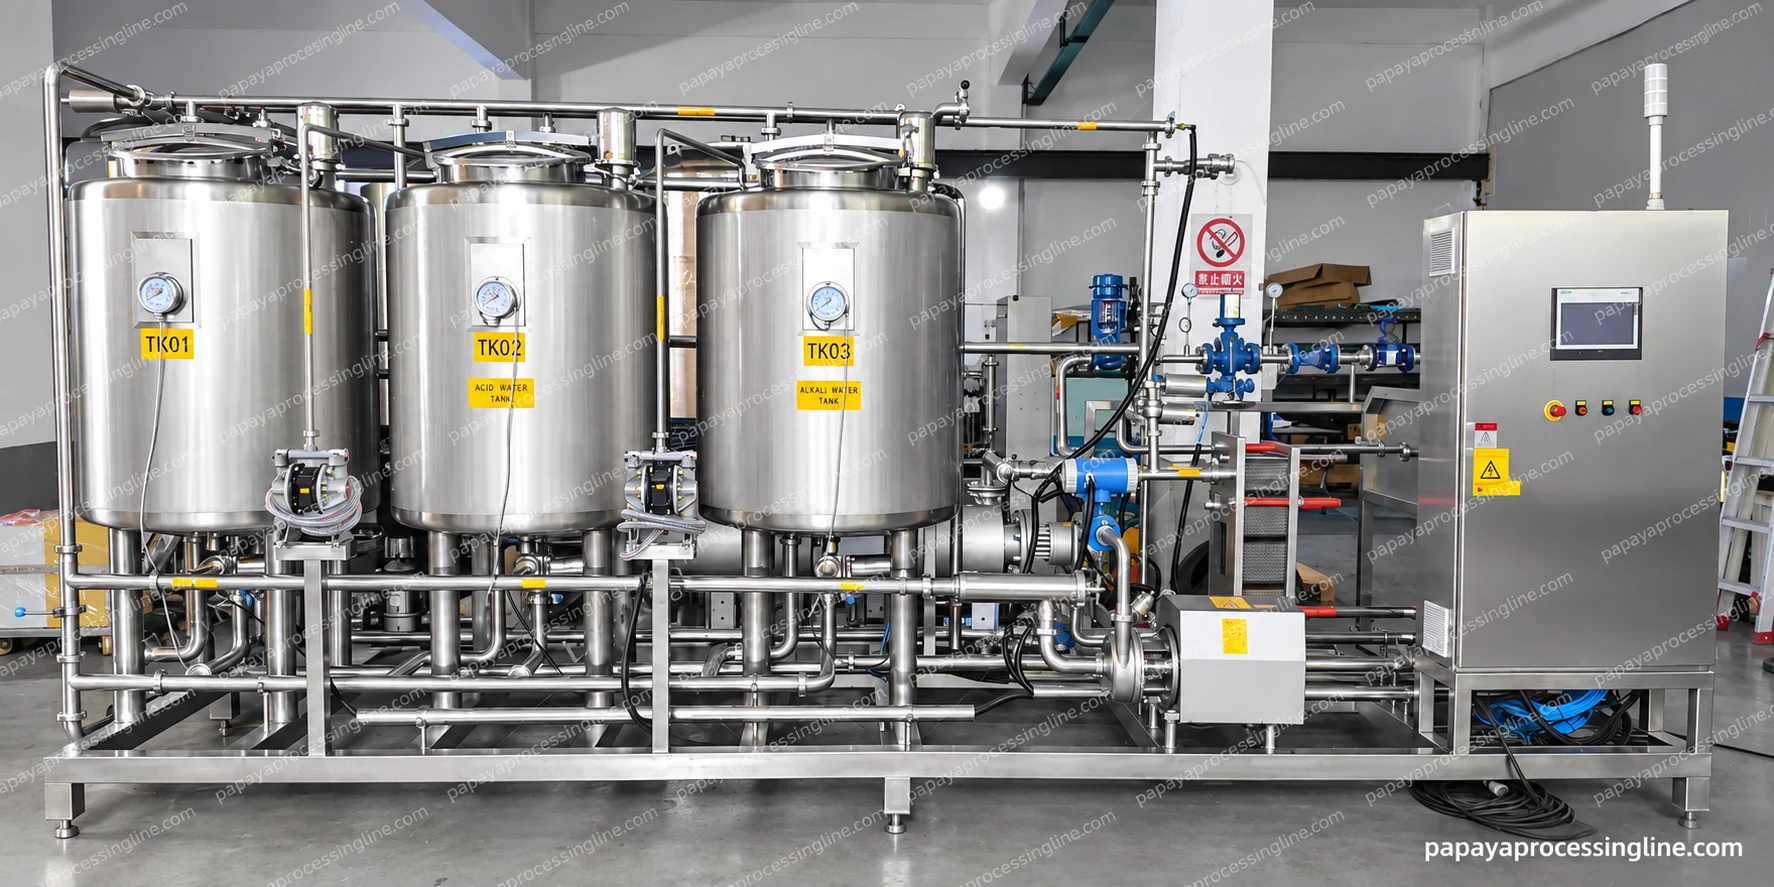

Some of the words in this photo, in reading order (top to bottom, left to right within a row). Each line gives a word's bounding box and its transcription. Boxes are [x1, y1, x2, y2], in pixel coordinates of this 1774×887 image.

[145, 336, 188, 353] TK01
[478, 339, 521, 356] TK02
[807, 343, 850, 359] TK03
